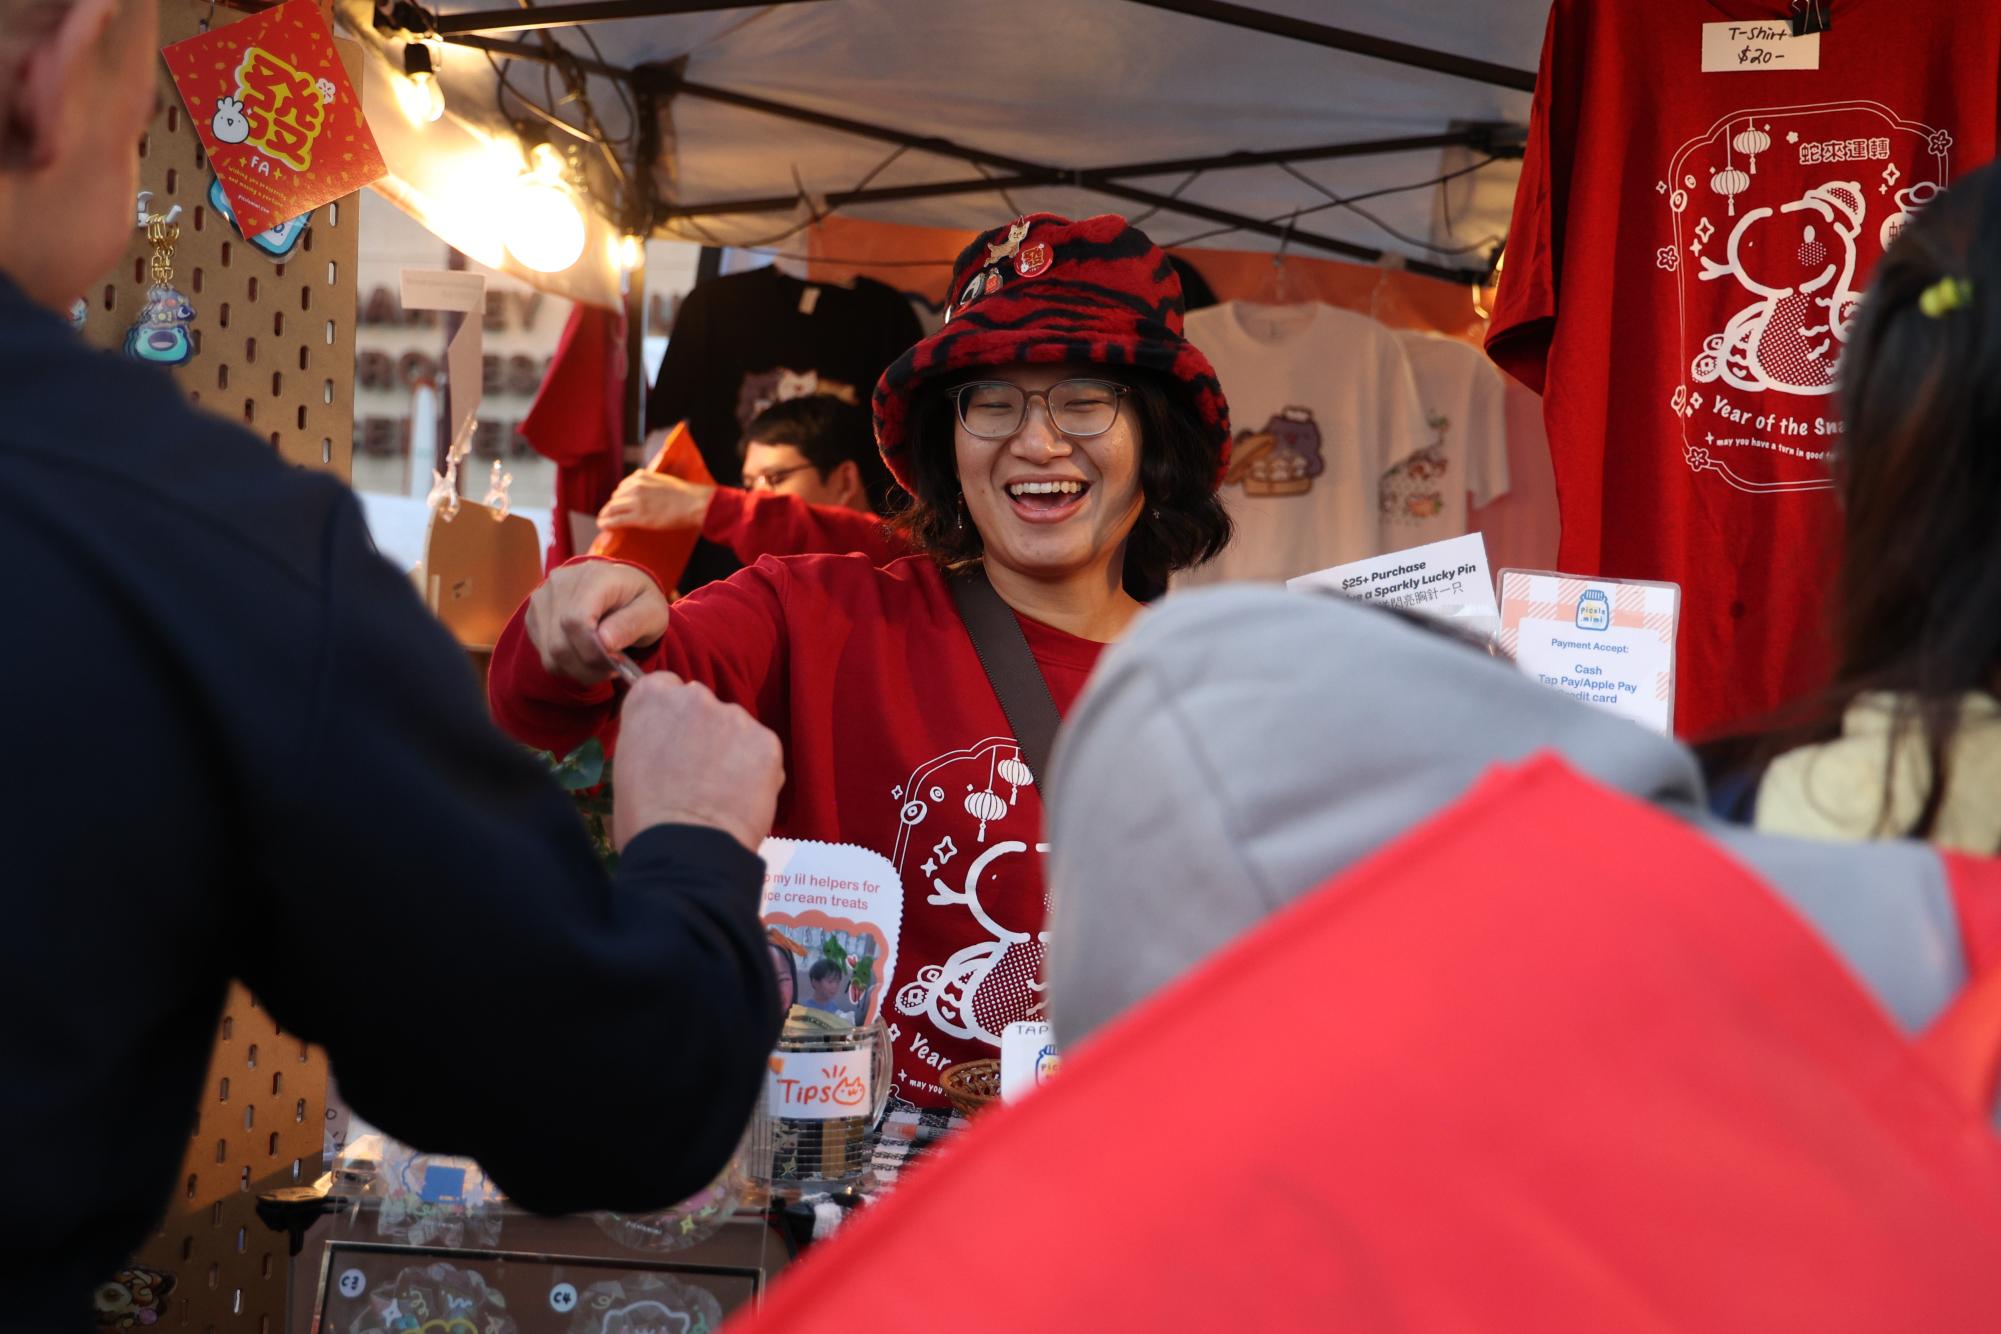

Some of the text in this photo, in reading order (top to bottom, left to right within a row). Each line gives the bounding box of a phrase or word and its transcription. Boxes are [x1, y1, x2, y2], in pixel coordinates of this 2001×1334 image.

[1729, 26, 1787, 41] T-Shirt
[1799, 137, 1890, 165] 蛇來運轉
[250, 155, 270, 177] FA
[1712, 394, 1753, 425] Year
[1755, 413, 1776, 432] of
[1779, 417, 1808, 436] the
[1716, 439, 1734, 447] may
[1736, 438, 1750, 447] you
[1751, 437, 1770, 449] have
[1778, 444, 1795, 455] turn
[1796, 447, 1804, 458] in
[1806, 451, 1824, 461] good
[1342, 561, 1427, 591] $25+ Purchase
[1364, 590, 1372, 600] a
[1374, 577, 1420, 599] Sparkly
[1422, 569, 1456, 585] Lucky
[1457, 563, 1477, 576] Pin
[1551, 638, 1630, 654] Payment Accept:
[1574, 664, 1603, 676] Cash
[1538, 674, 1638, 694] Tap Pay/Apple Pay
[1592, 694, 1618, 704] card
[773, 874, 792, 887] my
[794, 872, 806, 885] lil
[810, 876, 860, 891] helpers
[863, 880, 881, 894] for
[784, 892, 827, 905] cream
[831, 894, 869, 910] treats
[908, 1031, 953, 1072] Year
[777, 1078, 831, 1104] Tips
[909, 1079, 944, 1097] may you
